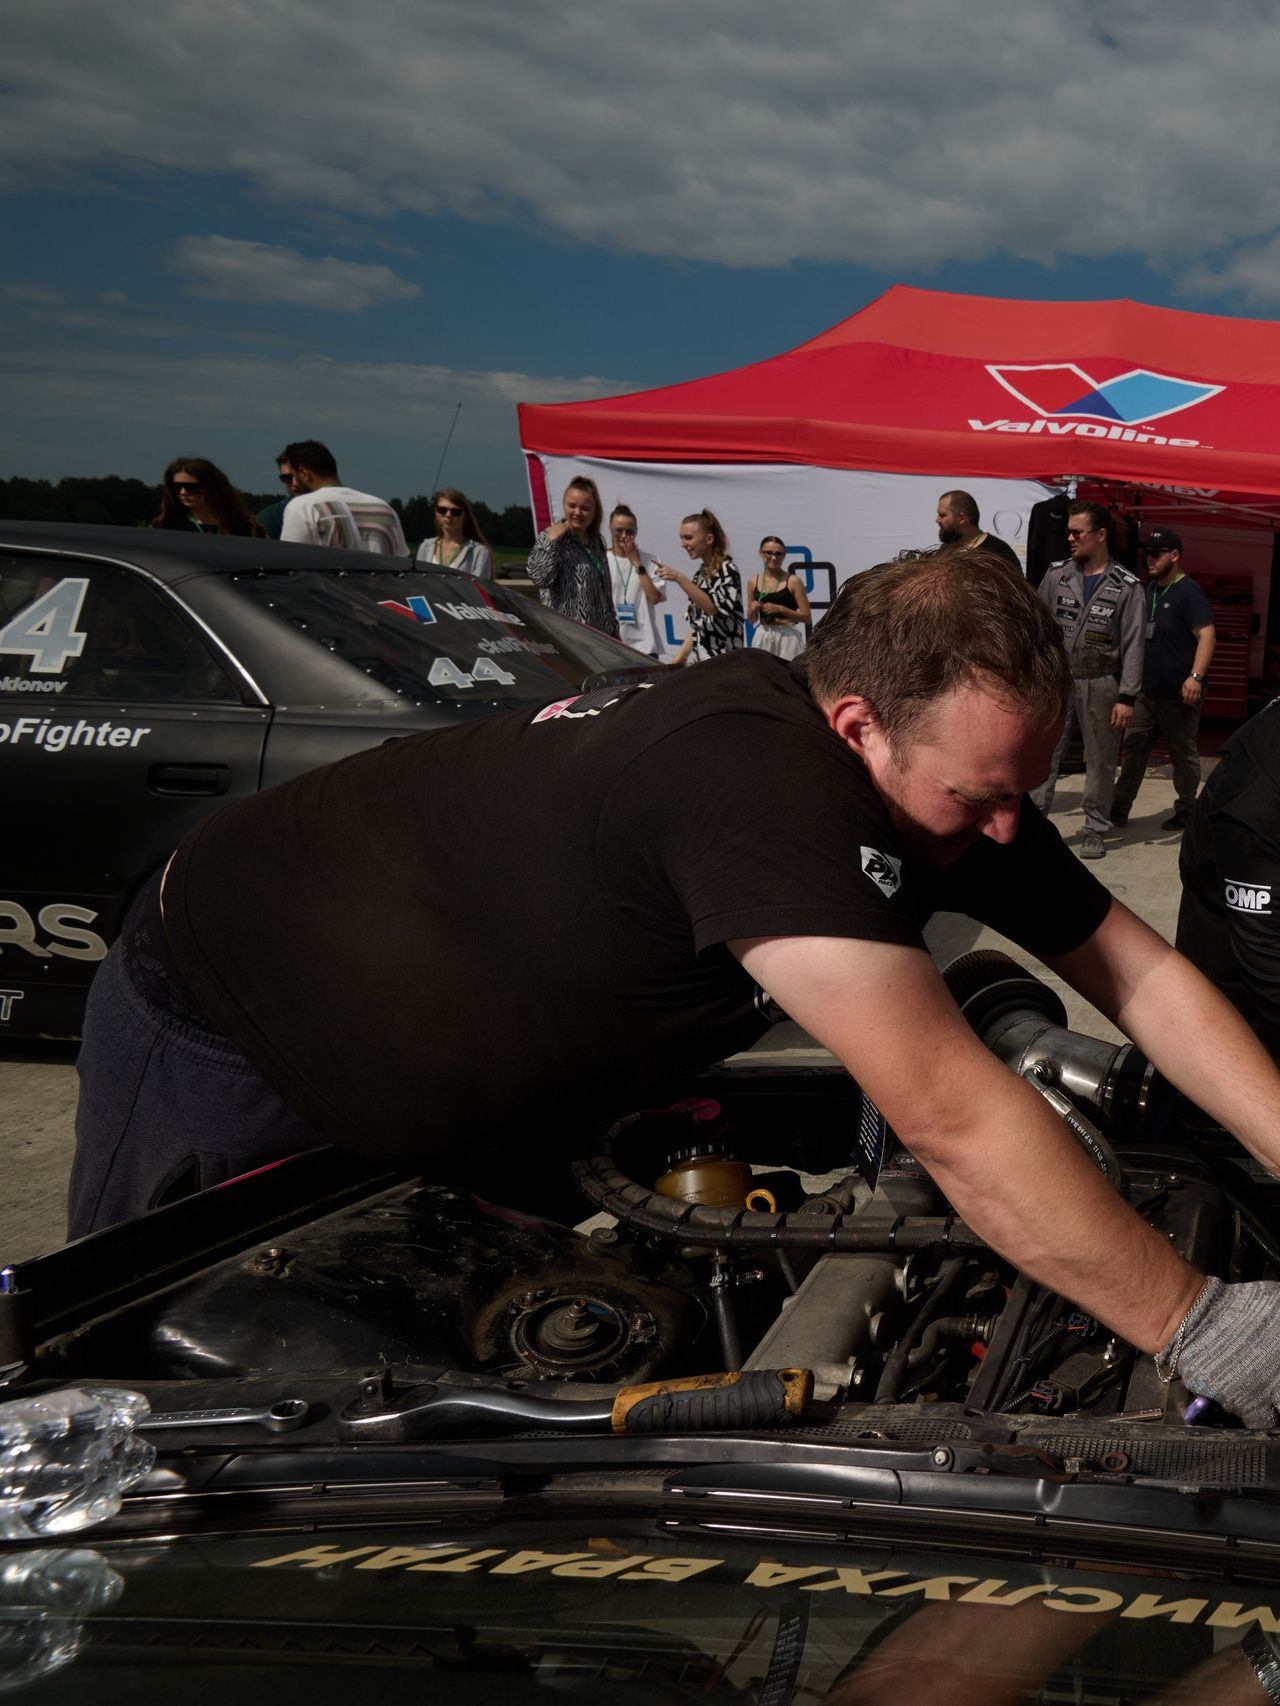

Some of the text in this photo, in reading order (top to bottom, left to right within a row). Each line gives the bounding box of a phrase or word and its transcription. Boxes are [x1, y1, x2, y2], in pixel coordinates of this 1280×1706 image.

[967, 419, 1200, 448] Valvoline
[0, 676, 68, 693] klonov
[427, 657, 517, 689] 44
[1225, 885, 1271, 909] OMP
[249, 1544, 725, 1583] БРАТАН
